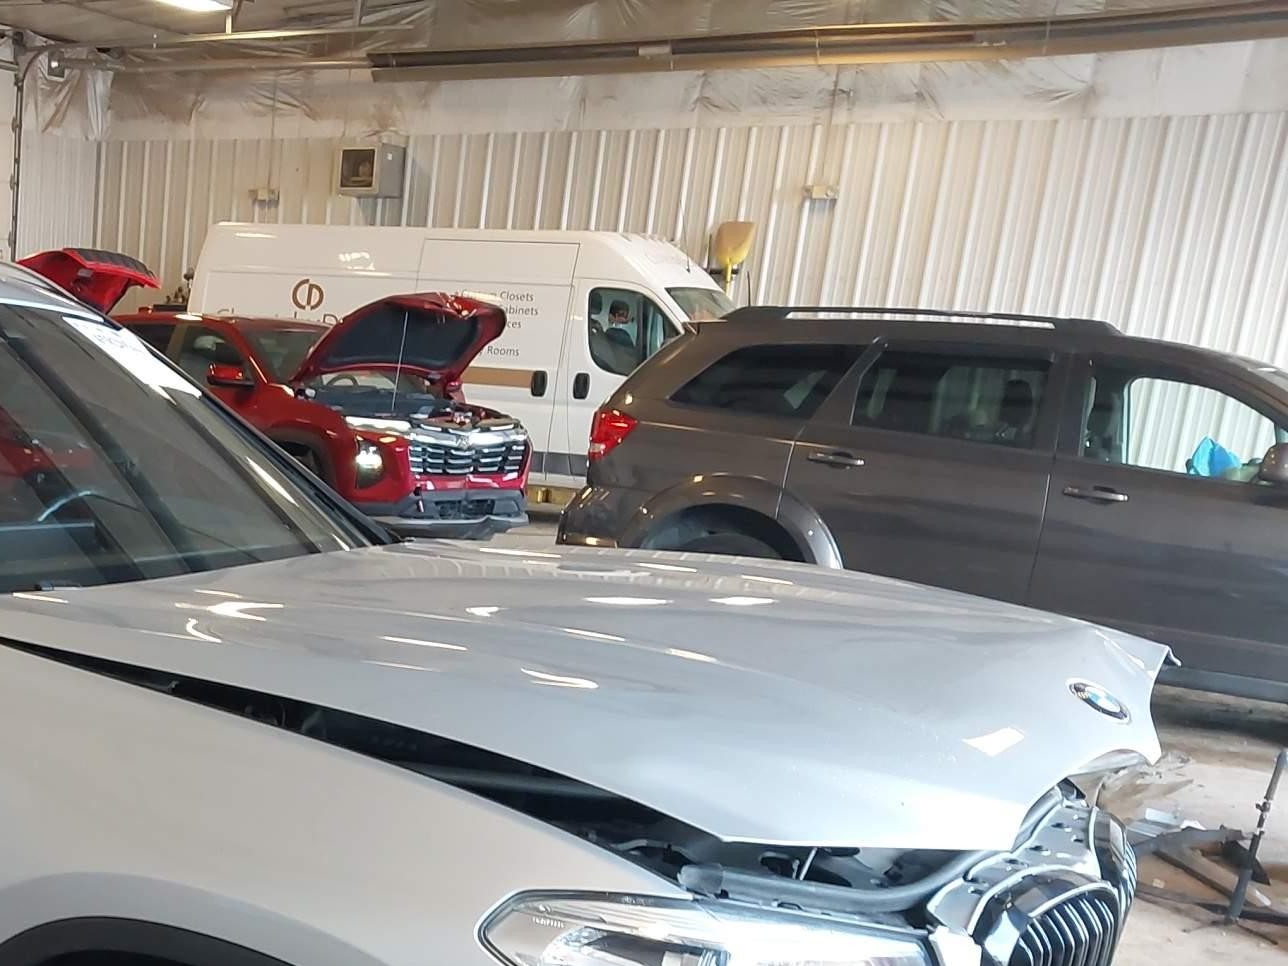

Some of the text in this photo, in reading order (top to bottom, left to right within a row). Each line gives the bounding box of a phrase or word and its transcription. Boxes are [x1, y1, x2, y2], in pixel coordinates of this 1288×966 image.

[500, 291, 534, 302] Closets
[503, 304, 539, 316] binets
[487, 346, 520, 357] Rooms
